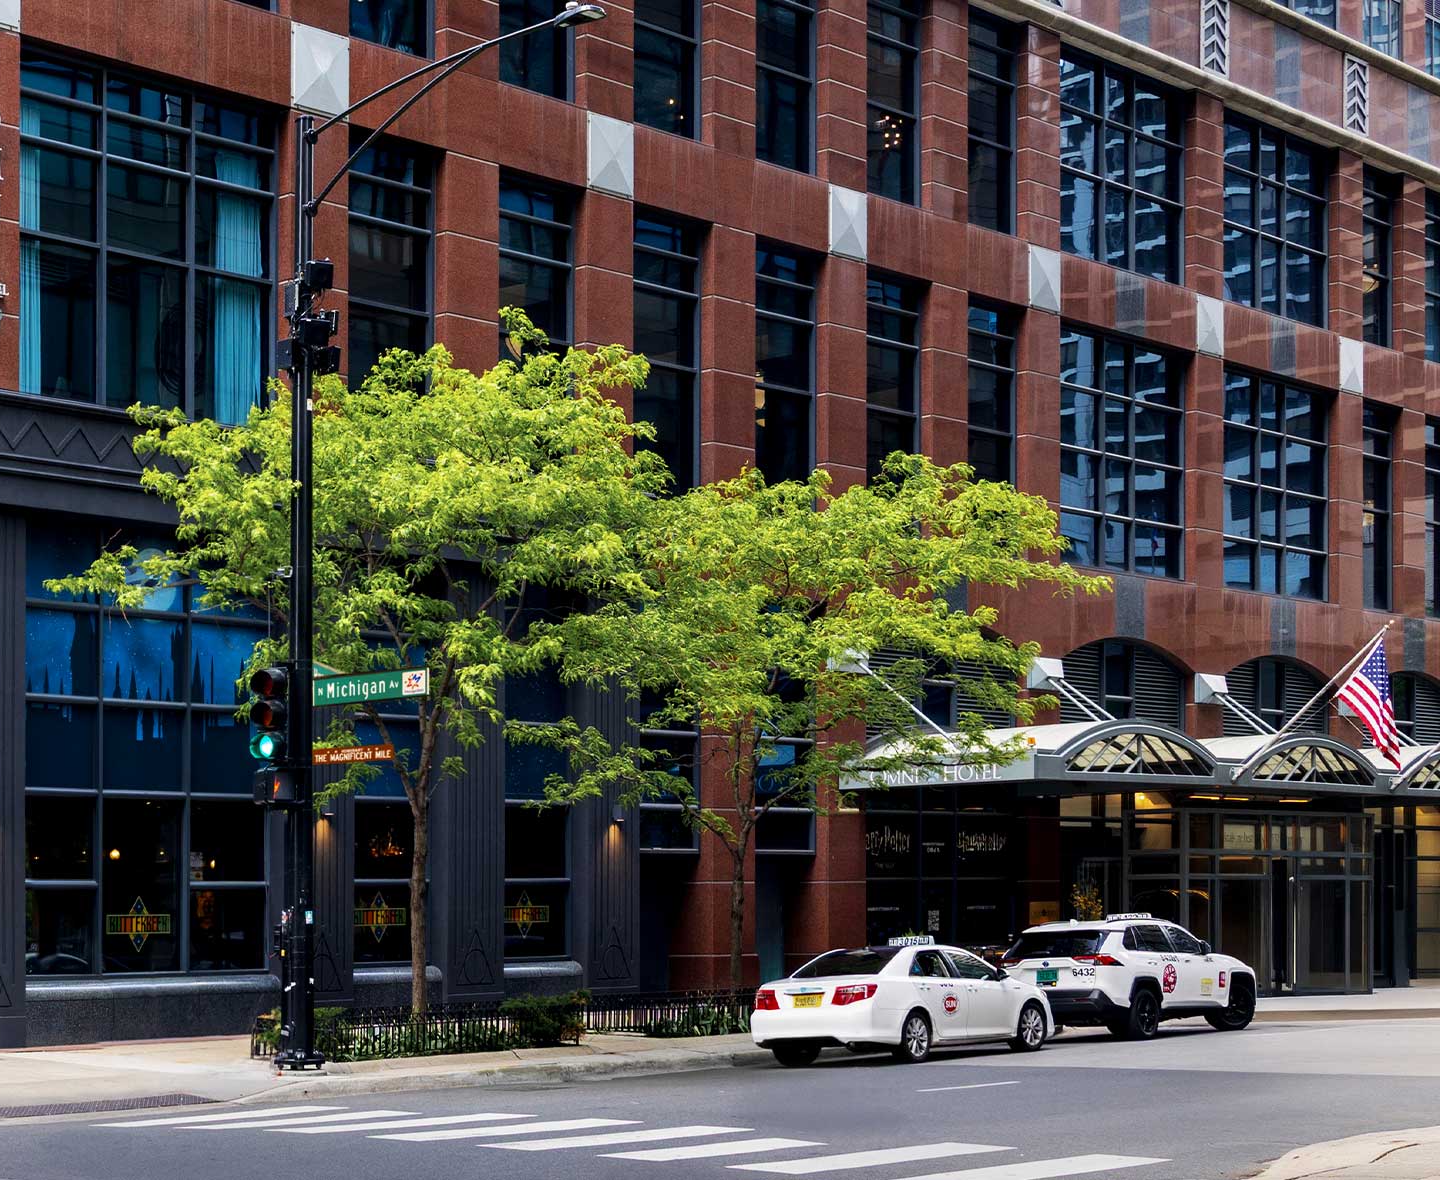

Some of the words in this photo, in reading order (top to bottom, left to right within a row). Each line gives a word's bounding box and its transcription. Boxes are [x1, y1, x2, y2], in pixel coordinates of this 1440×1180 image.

[318, 687, 324, 696] N
[327, 679, 386, 700] Michigan
[389, 680, 399, 689] Av
[314, 753, 327, 763] THE
[329, 751, 373, 761] MAGNIFICENT
[375, 749, 392, 760] MILE
[1072, 968, 1095, 977] 6432
[946, 1000, 957, 1008] SUN
